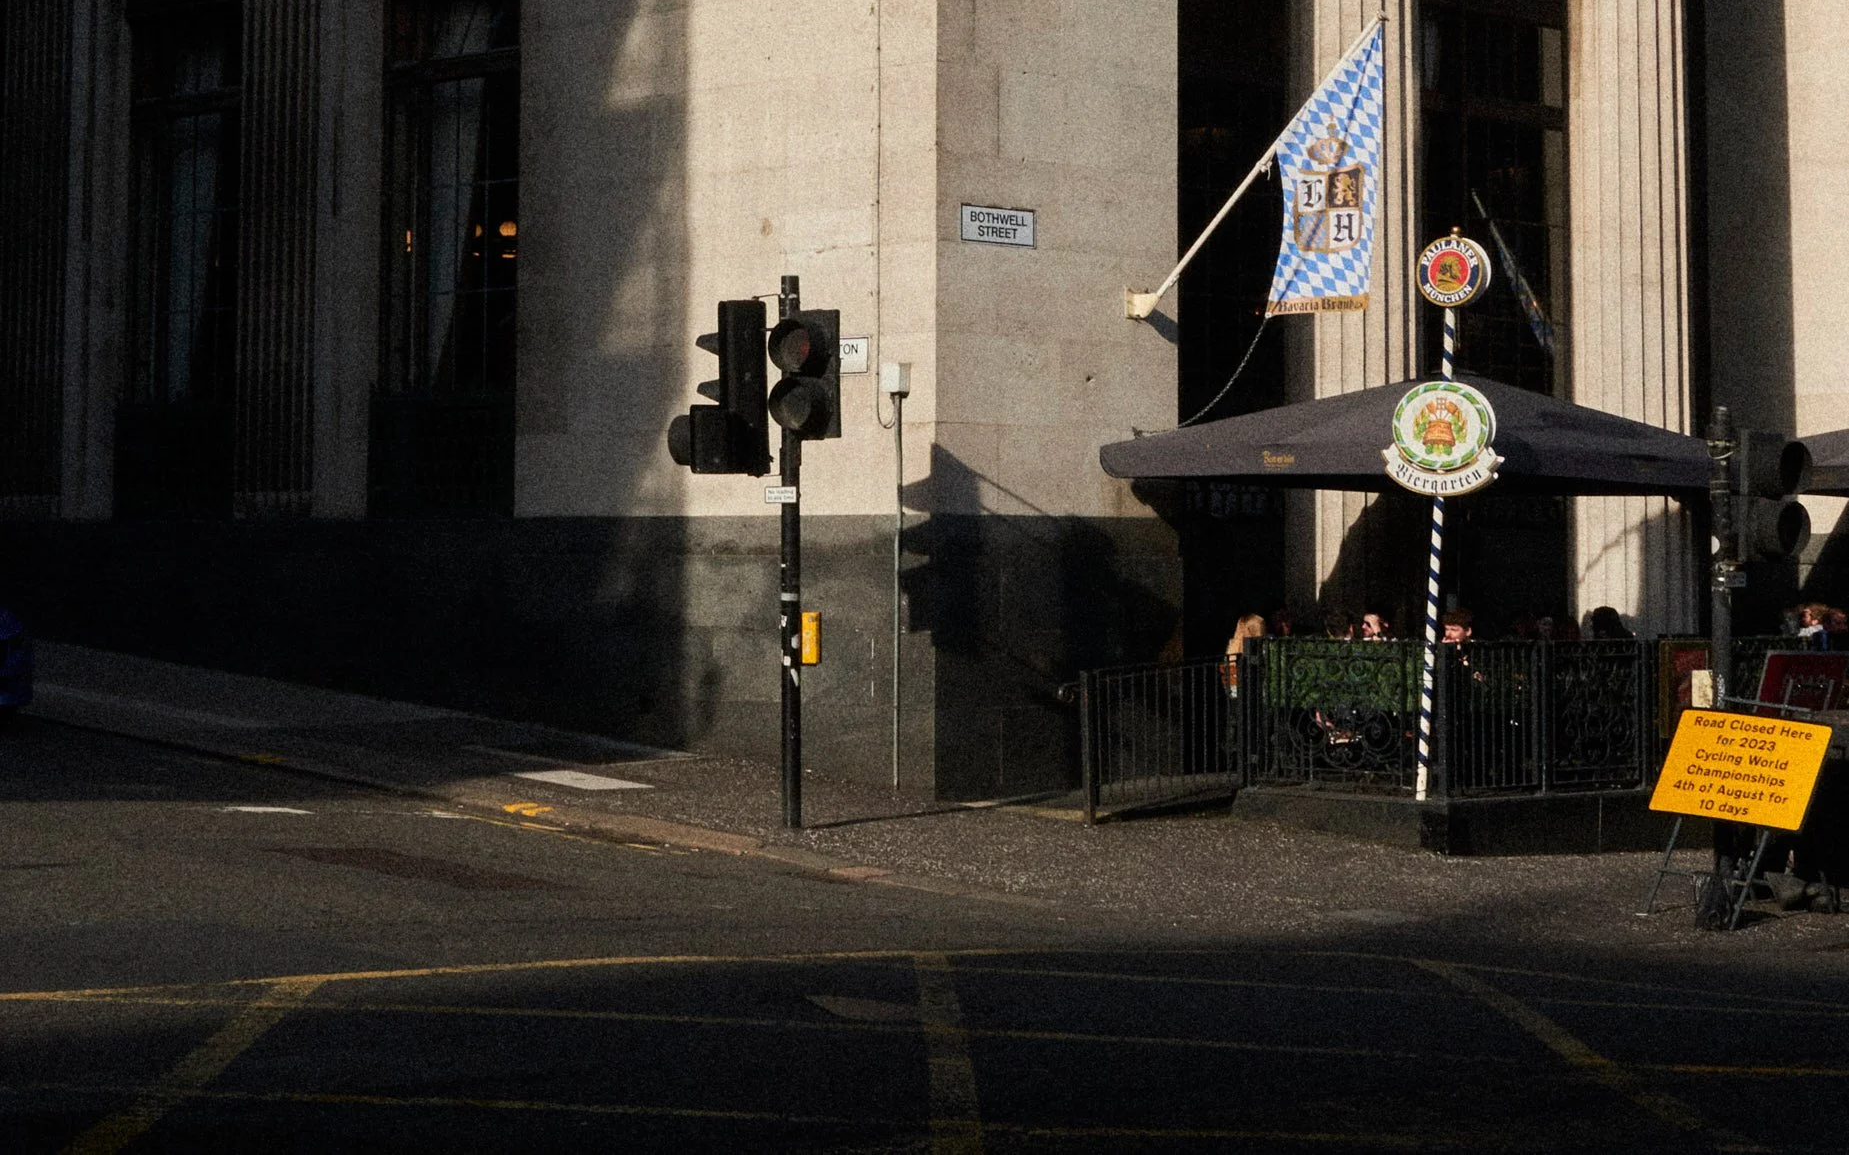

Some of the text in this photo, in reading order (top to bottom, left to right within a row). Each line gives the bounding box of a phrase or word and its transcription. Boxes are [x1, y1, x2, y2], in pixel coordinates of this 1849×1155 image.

[970, 211, 1027, 226] BOTHWELL
[977, 225, 1018, 239] STREET
[1421, 240, 1478, 268] PAULANER
[1278, 299, 1320, 312] Bavaria
[1395, 463, 1482, 494] Biergarten
[1694, 716, 1813, 741] Road Closed Here
[1716, 735, 1776, 752] for 2023
[1695, 749, 1789, 771] Cycling World
[1687, 764, 1786, 787] Championships
[1673, 779, 1788, 804] 4th of August for
[1700, 800, 1749, 816] 10 days
